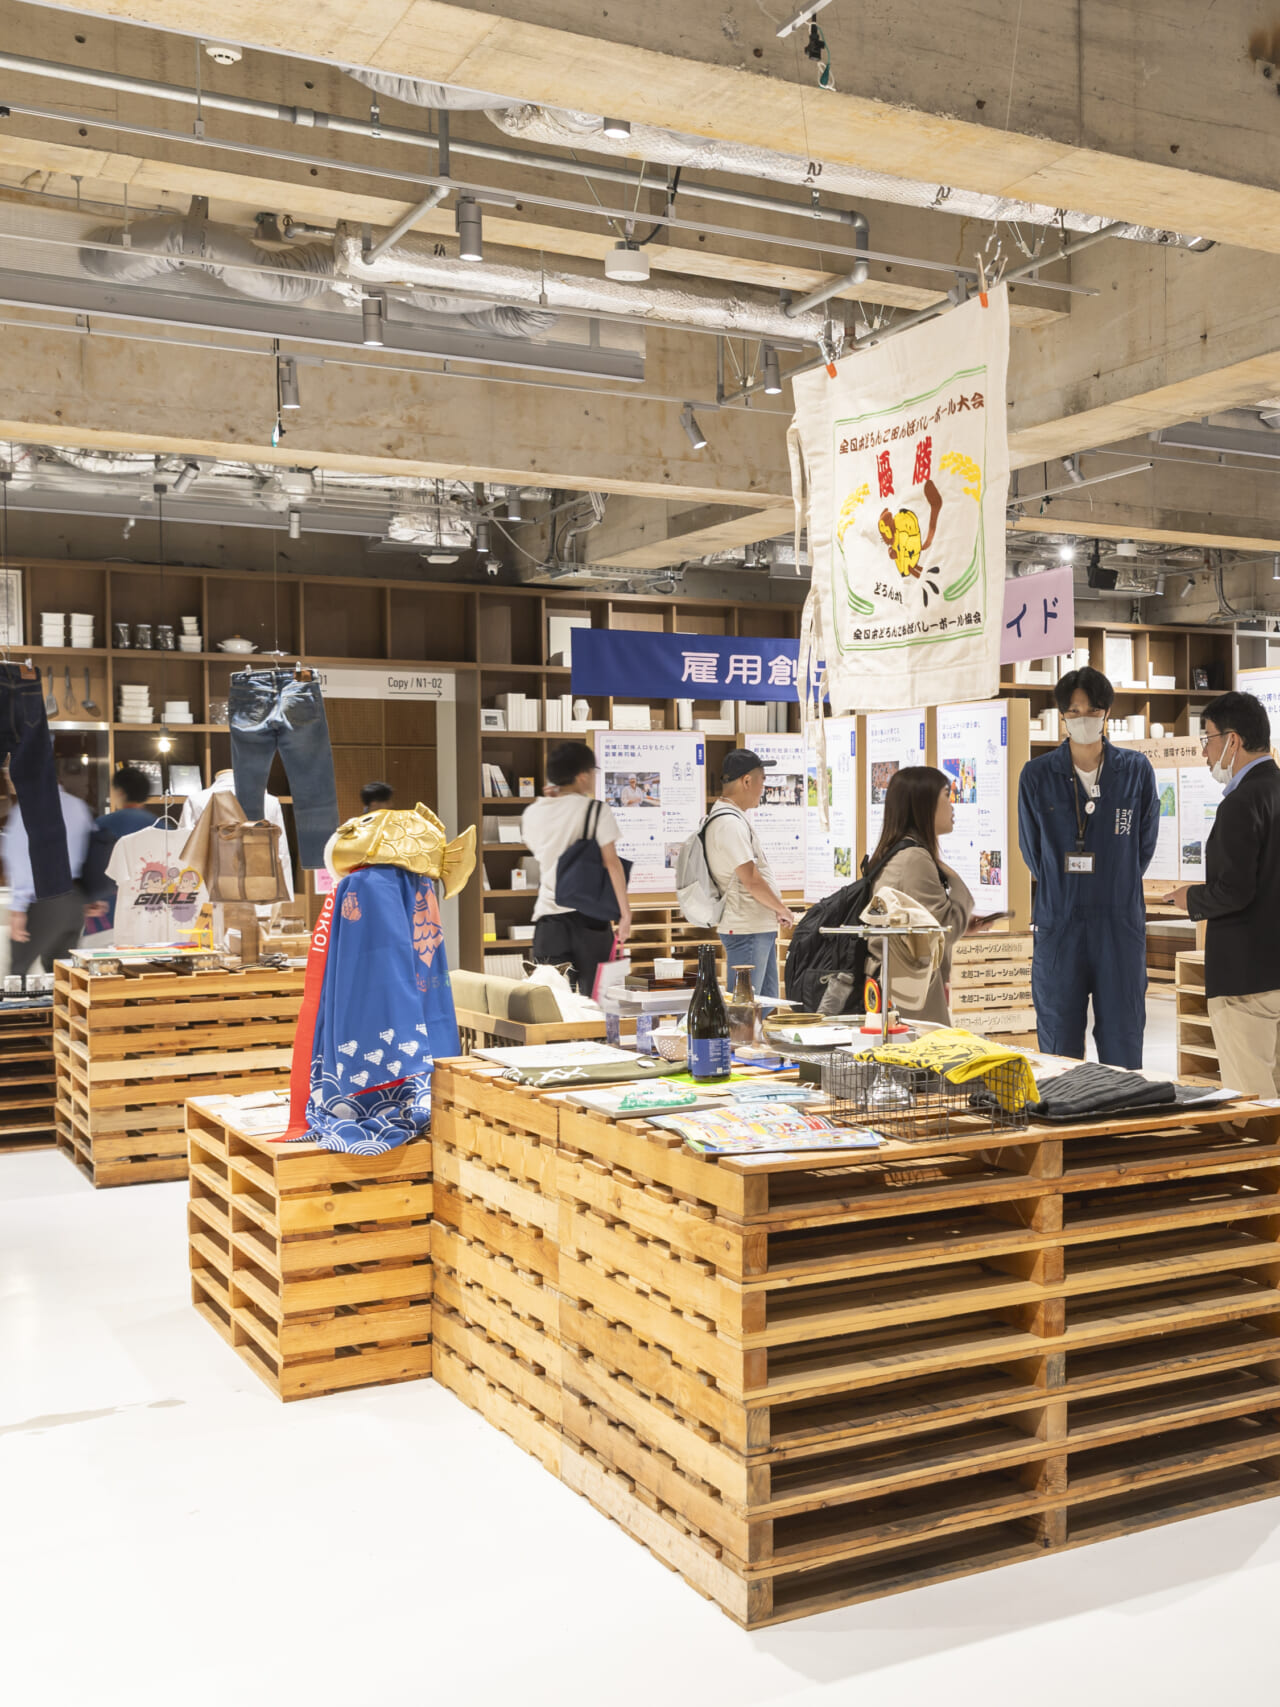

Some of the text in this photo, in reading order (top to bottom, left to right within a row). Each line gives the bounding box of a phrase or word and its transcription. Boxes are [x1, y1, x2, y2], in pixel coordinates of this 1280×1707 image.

[388, 677, 408, 690] Copy
[416, 678, 442, 689] N1-02
[134, 892, 199, 906] GIRLS
